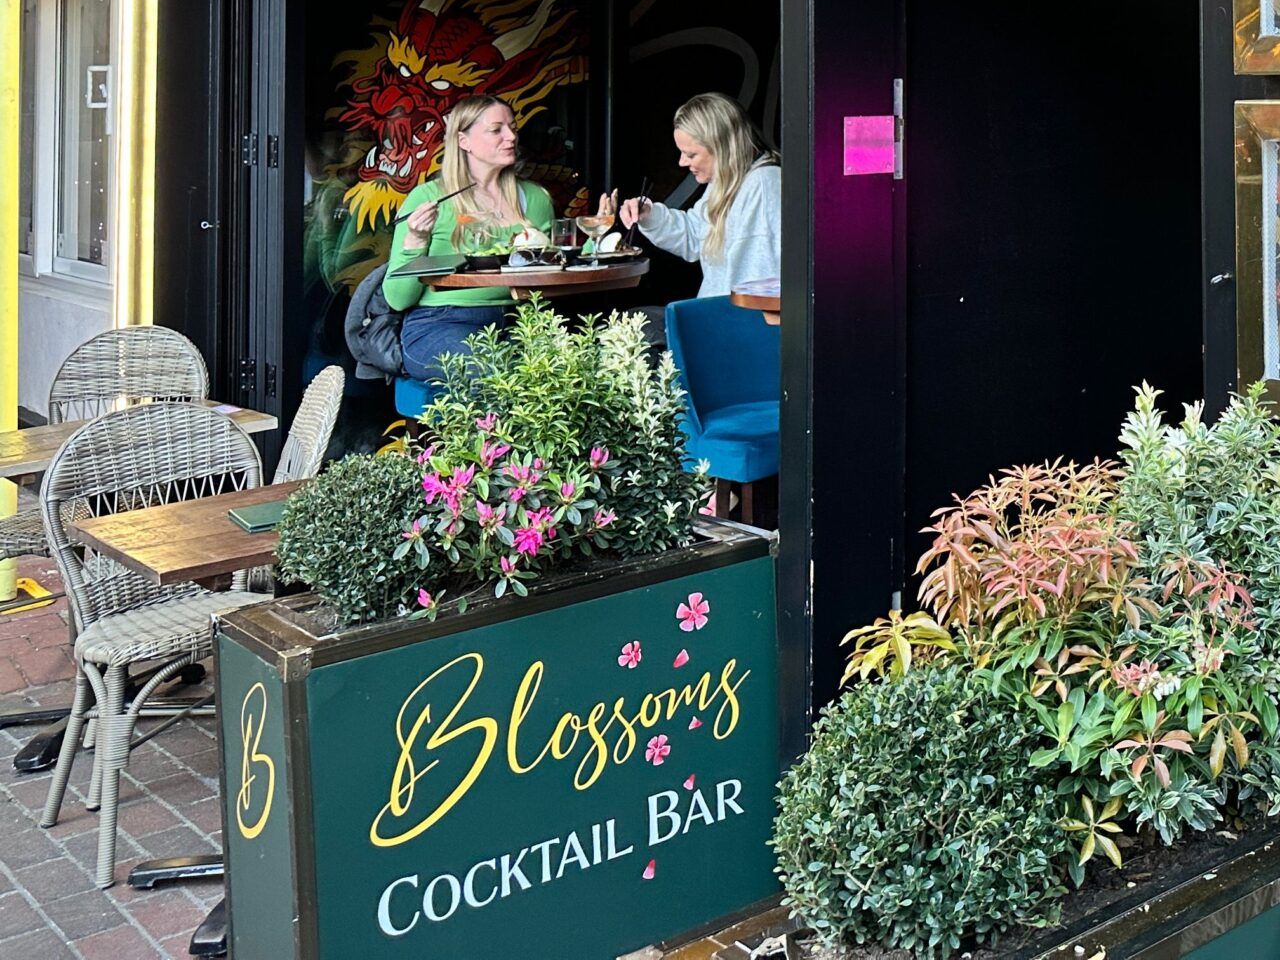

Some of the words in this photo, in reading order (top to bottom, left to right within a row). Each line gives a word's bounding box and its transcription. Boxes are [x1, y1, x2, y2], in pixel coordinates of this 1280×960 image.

[368, 651, 751, 848] Blossoms
[377, 818, 635, 936] COCKTAIL
[647, 778, 745, 848] BAR
